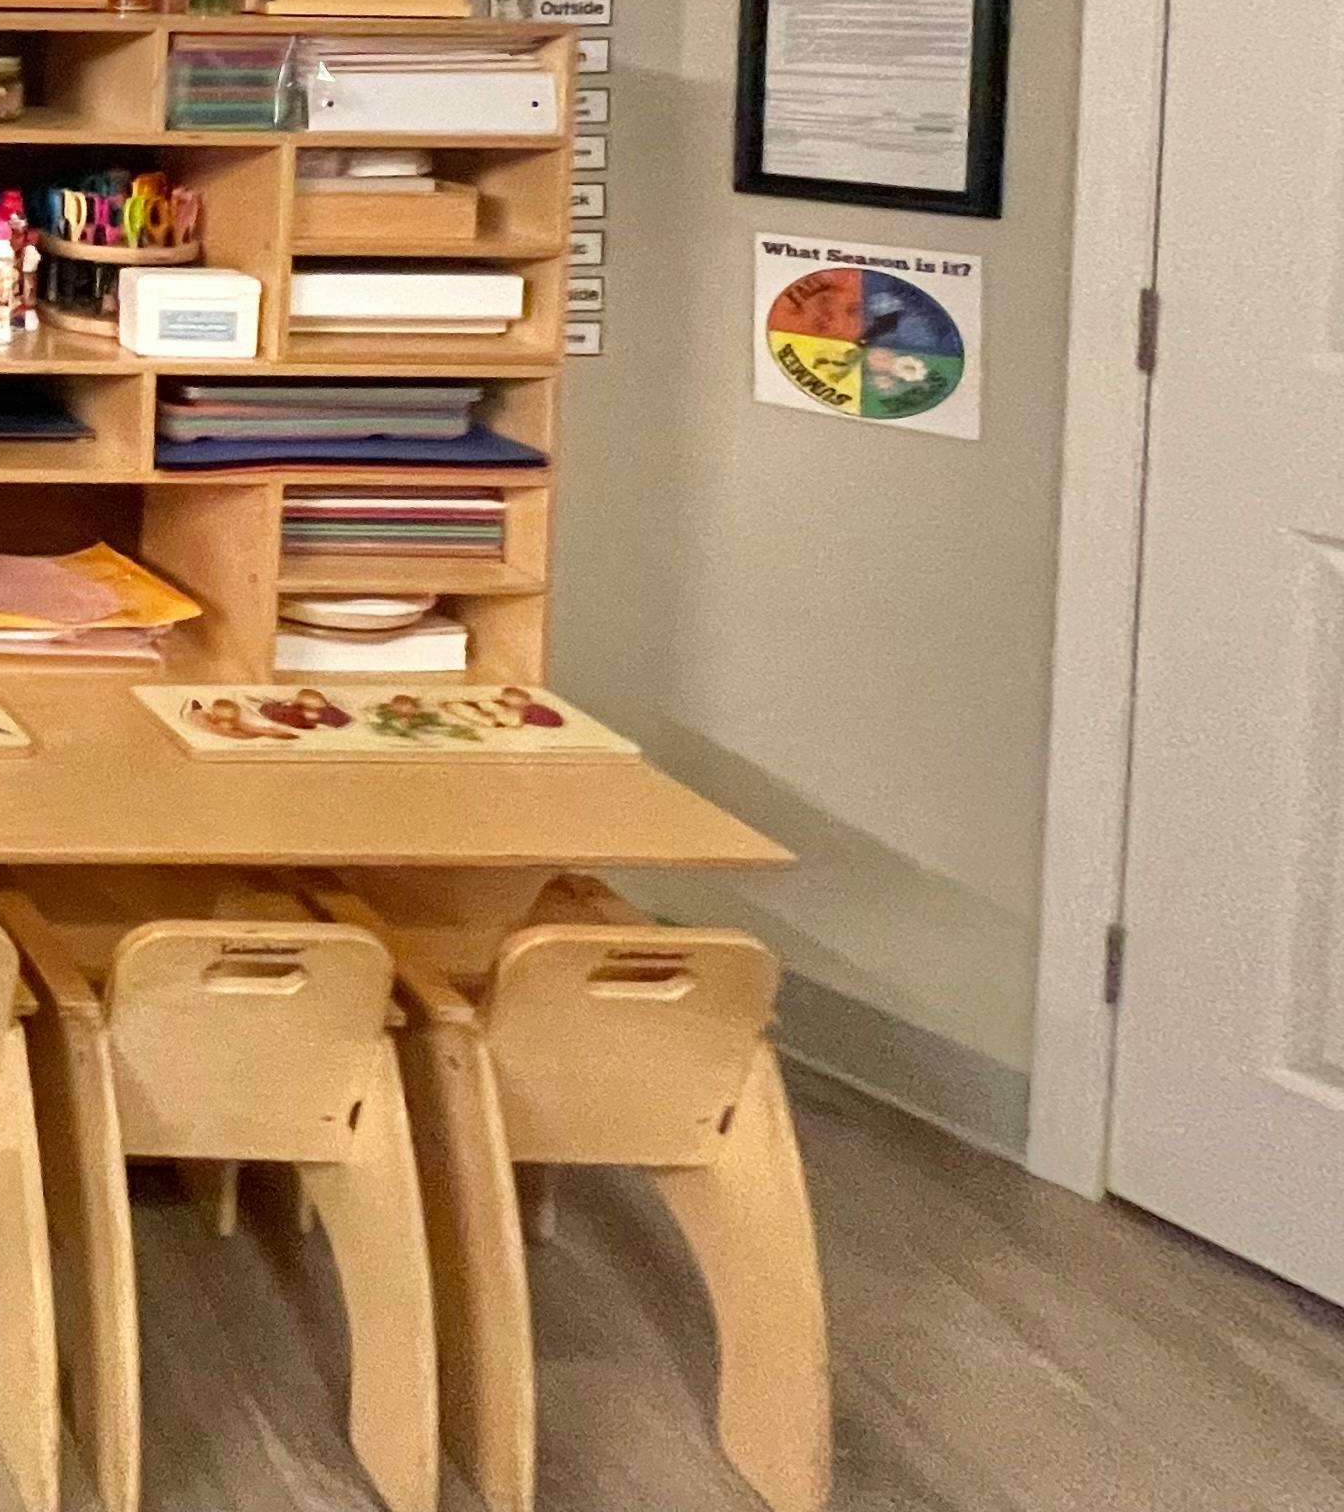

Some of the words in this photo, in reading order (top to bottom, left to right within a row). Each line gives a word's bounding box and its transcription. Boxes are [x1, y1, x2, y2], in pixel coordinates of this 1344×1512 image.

[540, 1, 604, 16] Outside
[762, 241, 820, 261] What
[826, 249, 910, 271] Season
[915, 258, 936, 273] is
[942, 261, 972, 277] it?
